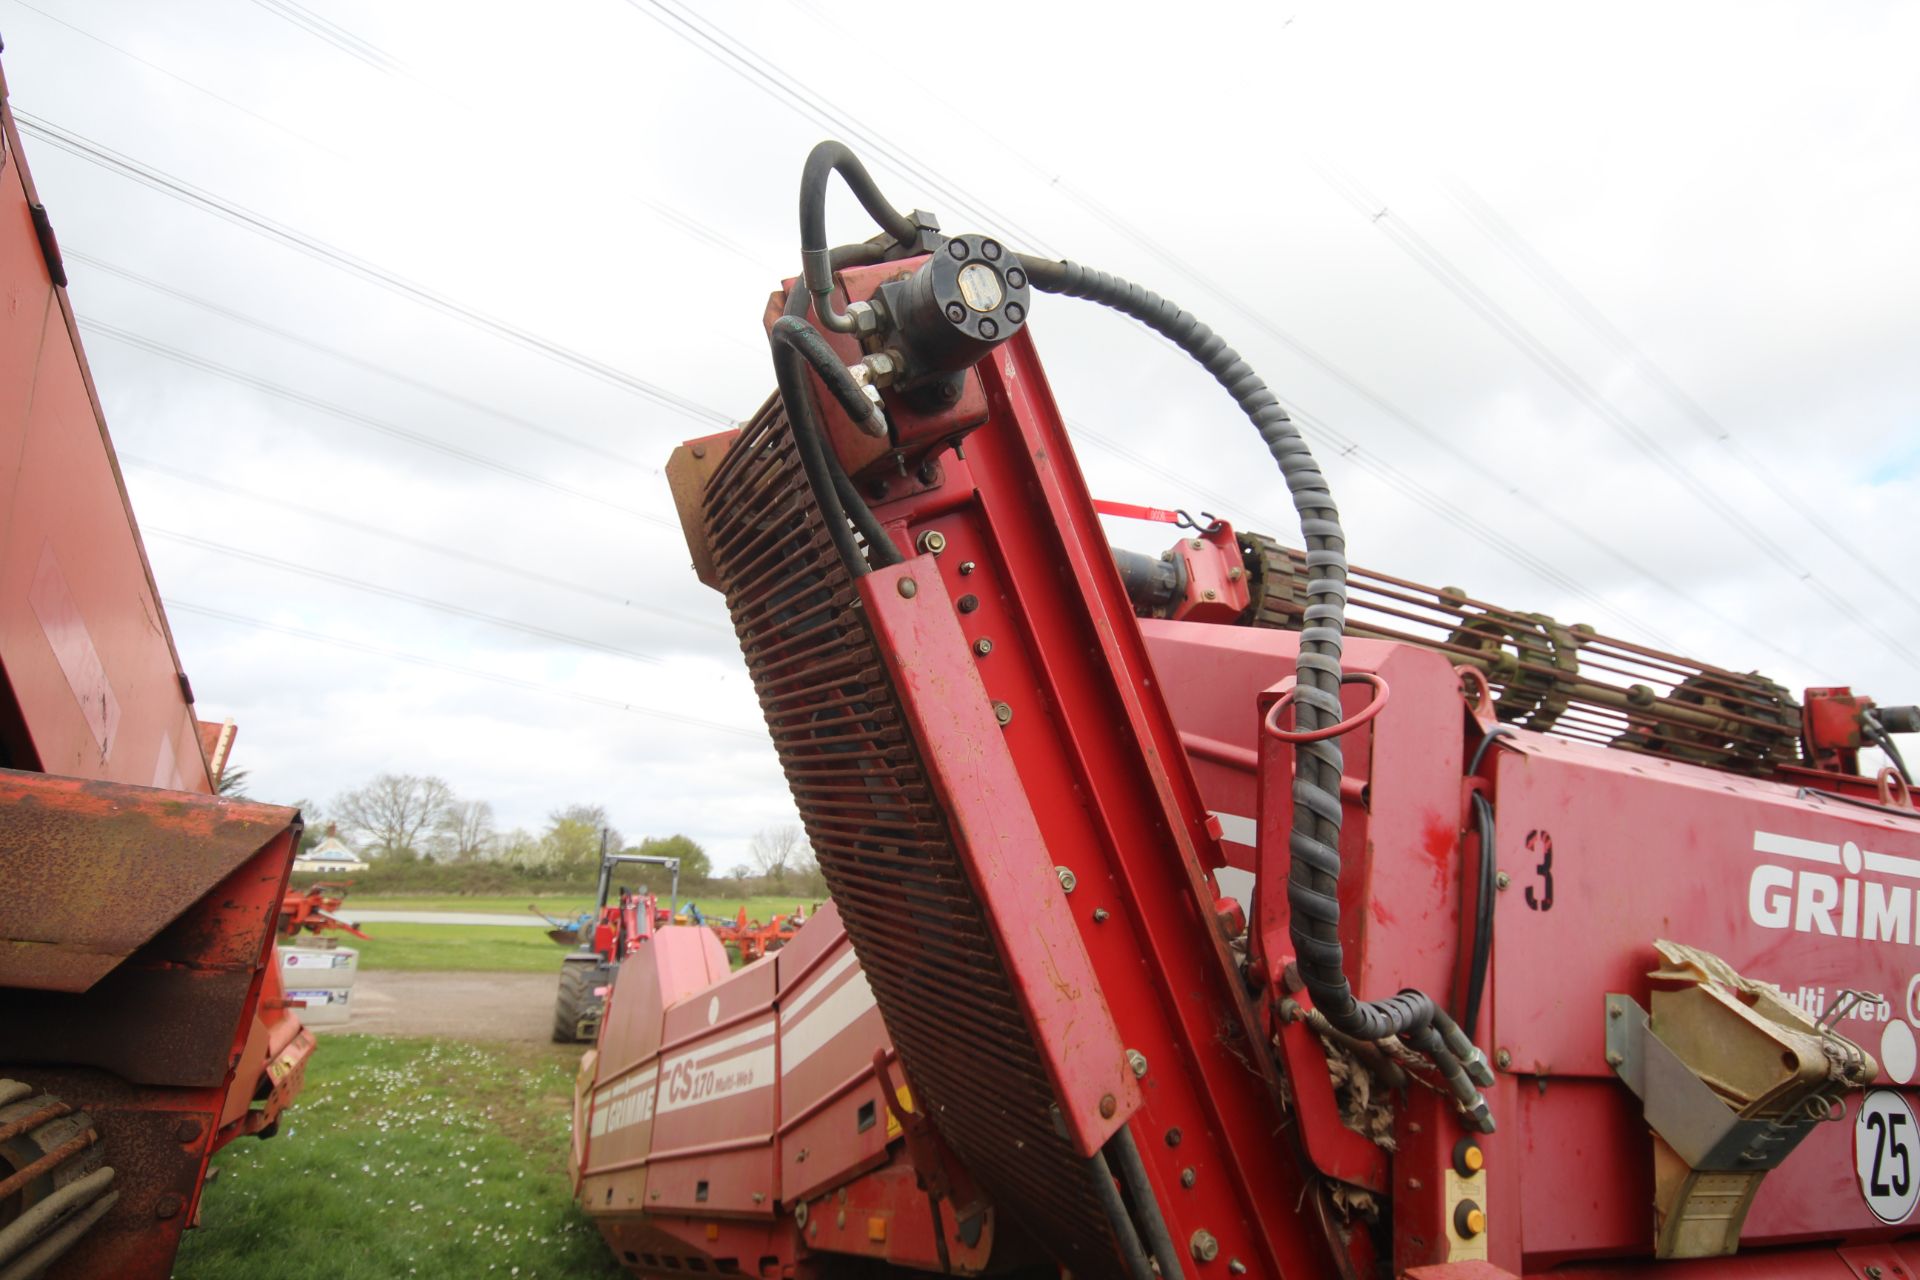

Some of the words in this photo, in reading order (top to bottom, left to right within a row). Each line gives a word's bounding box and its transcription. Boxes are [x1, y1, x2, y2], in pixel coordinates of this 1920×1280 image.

[1525, 829, 1553, 912] 3
[1749, 864, 1920, 946] GRIM
[1866, 1111, 1910, 1197] 25
